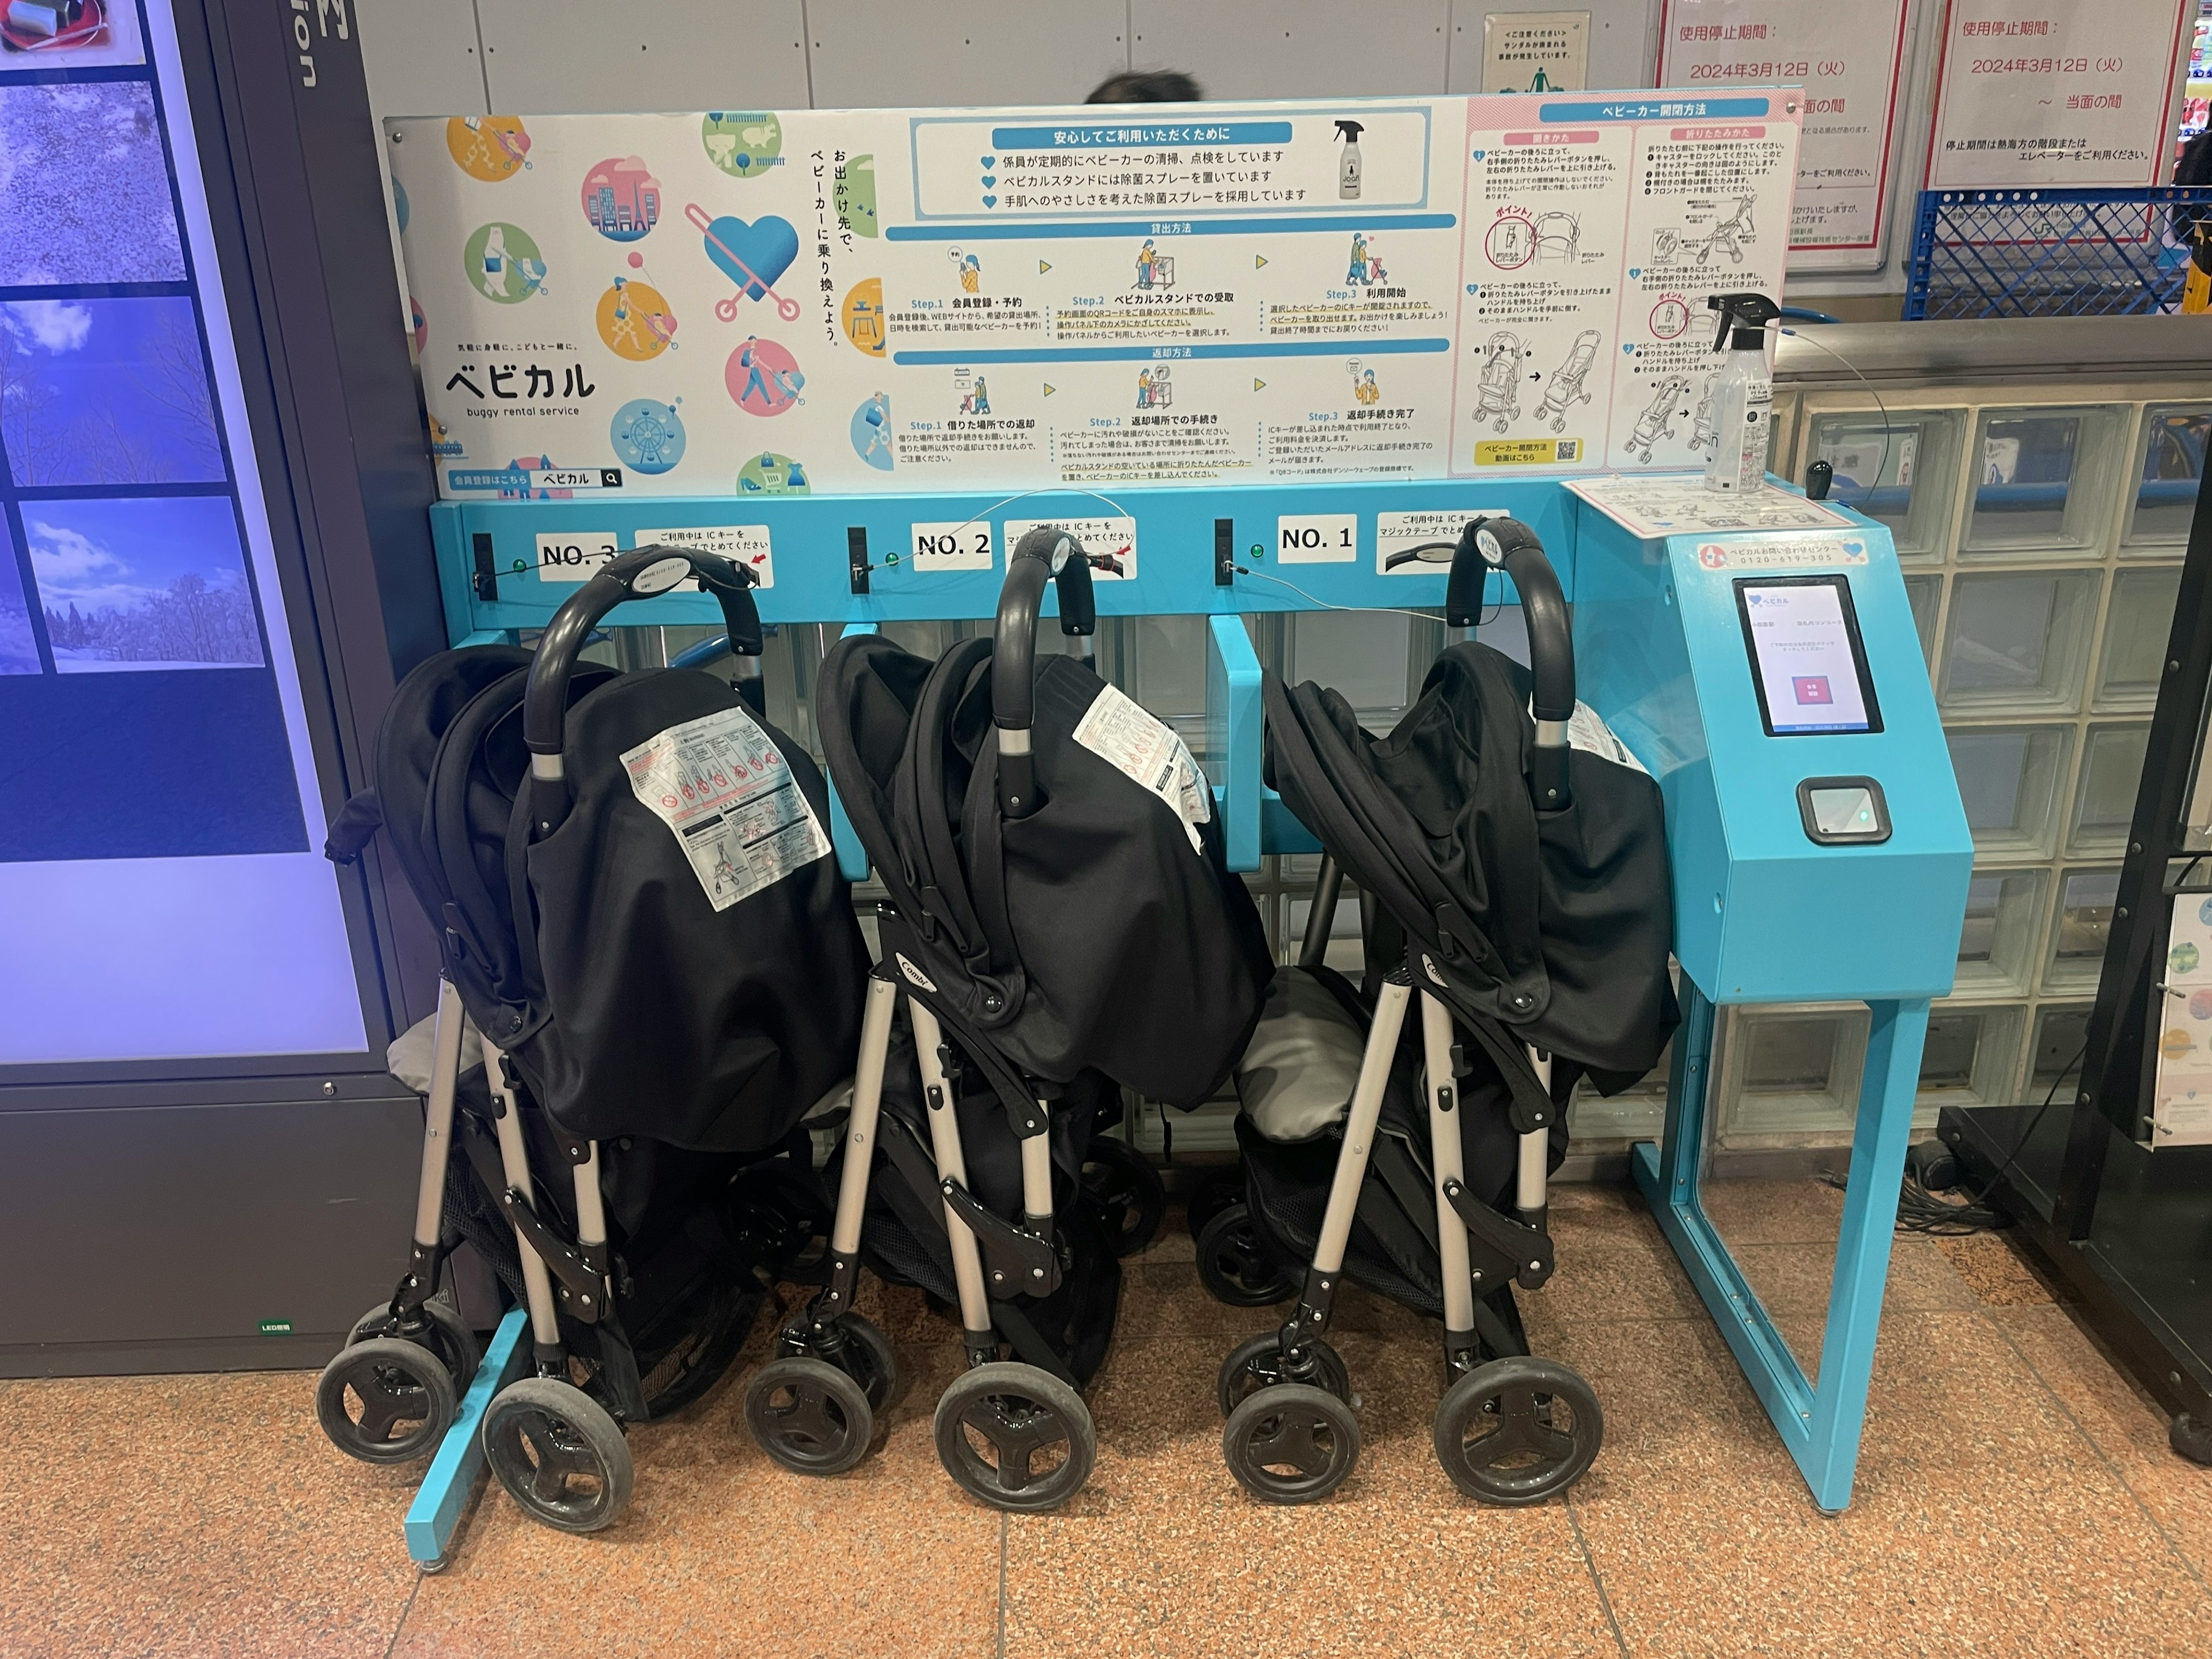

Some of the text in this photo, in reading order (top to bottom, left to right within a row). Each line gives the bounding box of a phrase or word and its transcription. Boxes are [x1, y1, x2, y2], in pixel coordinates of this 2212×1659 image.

[1680, 24, 1776, 41] 使用停止期間:
[1963, 21, 2058, 36] 使用停止期間:
[2066, 94, 2122, 109] 当面の間
[1603, 103, 1706, 118] ベビーカー開閉方法
[1054, 127, 1230, 145] 安心してご利用いただくために
[1533, 134, 1569, 144] 開きかた
[1686, 128, 1750, 139] 折りたたみかた
[1946, 138, 2086, 151] 停止期間は熱海方の階段または
[1487, 147, 1570, 156] ベビーカーの後ろに立って、
[2019, 150, 2149, 161] エレベーターをご利用ください。
[1003, 150, 1283, 168] 係員が定期的にベビーカーの清掃、点検をしています
[1004, 170, 1272, 187] ベビカルスタンドには除菌スプレーを置いています
[835, 150, 853, 252] お出かけ先で、
[1005, 190, 1306, 207] 手肌へのやさしさを考えた除菌スプレーを採用しています
[1151, 222, 1192, 234] 貸出方法
[811, 150, 838, 346] ベビーカーに乗り換えよう。
[1643, 266, 1721, 274] ベビーカーの後ろに立って
[1480, 281, 1561, 290] ベビーカーの後ろに立って、
[1326, 287, 1407, 300] Step.3 利用開始
[912, 297, 1022, 310] Step.1 会員登録・予約
[1073, 293, 1234, 307] Step.2 ベビカルスタンドでの受取
[1487, 298, 1546, 306] ハンドルを持ち上げ
[1056, 308, 1215, 319] 予約画面のQRコードをご自身のスマホに表示し、
[1057, 319, 1191, 329] 操作パネル下のカメラにかざしてください。
[1057, 328, 1230, 340] 操作パネルからご利用したいベビーカーを選択します。
[1152, 347, 1192, 358] 返却方法
[446, 363, 595, 399] ベビカル
[467, 407, 579, 418] buggy rental service
[1309, 408, 1414, 422] Step.3 返却手続き完了
[911, 419, 1035, 431] Step.1 借りた場所での返却
[1090, 415, 1218, 428] Step.2 返却場所での手続き
[1268, 422, 1411, 433] ICキーが差し込まれた時点で利用終了となり、
[899, 433, 1029, 443] 借りた場所で返却手続きをお願いします。
[1060, 427, 1230, 439] ベビーカーに汚れや破損がないことをご確認ください。
[1268, 434, 1349, 444] ご利用料金を決済します。
[900, 442, 1036, 453] 借りた場所以外での返却はできませんので、
[1268, 442, 1433, 454] ご登録いただいたメールアドレスに返却手続き完了の
[1484, 444, 1547, 452] ベビーカー開閉方法
[900, 454, 952, 463] ご注意ください。
[1268, 455, 1324, 464] メールが届きます。
[1495, 454, 1535, 462] 動画はこちら
[455, 475, 527, 485] 会員登録はこちら
[544, 473, 589, 485] ベビカル
[1403, 515, 1443, 524] ご利用中は
[1459, 514, 1475, 522] キー
[1074, 522, 1083, 531] IC
[1085, 522, 1101, 530] キー
[1104, 521, 1111, 529] を
[1380, 527, 1438, 536] マジックテープ
[661, 530, 744, 541] ご利用中は IC キー を
[1074, 533, 1133, 541] とめてください
[1283, 528, 1352, 548] NO. 1
[918, 535, 964, 555] NO.
[975, 534, 990, 554] 2
[543, 546, 590, 565] NO.
